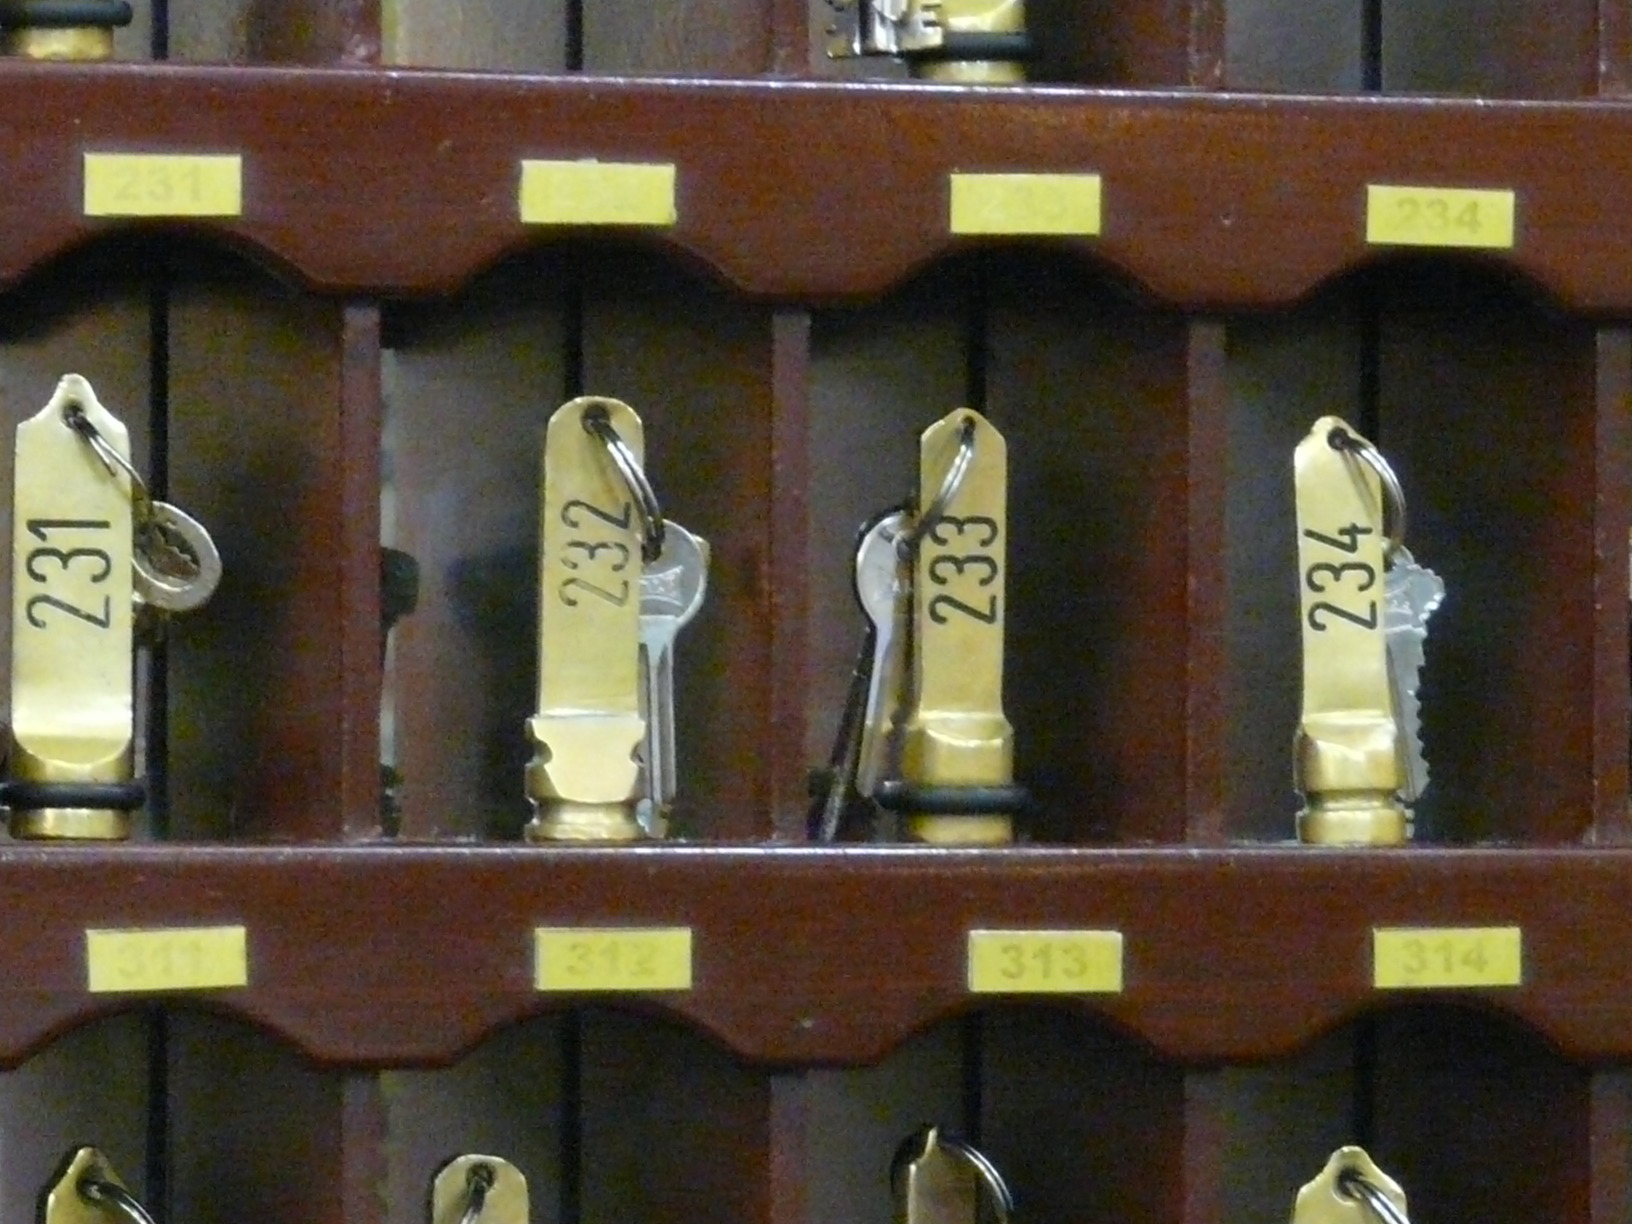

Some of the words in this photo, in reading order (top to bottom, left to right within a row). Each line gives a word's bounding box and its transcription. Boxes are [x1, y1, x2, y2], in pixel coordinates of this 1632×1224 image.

[112, 163, 204, 206] 231
[1395, 195, 1483, 236] 234
[25, 517, 112, 631] 231
[558, 498, 633, 611] 232
[929, 513, 999, 627] 233
[1306, 523, 1378, 633] 234
[566, 939, 656, 977] 312
[999, 942, 1090, 981] 313
[1400, 938, 1490, 976] 314
